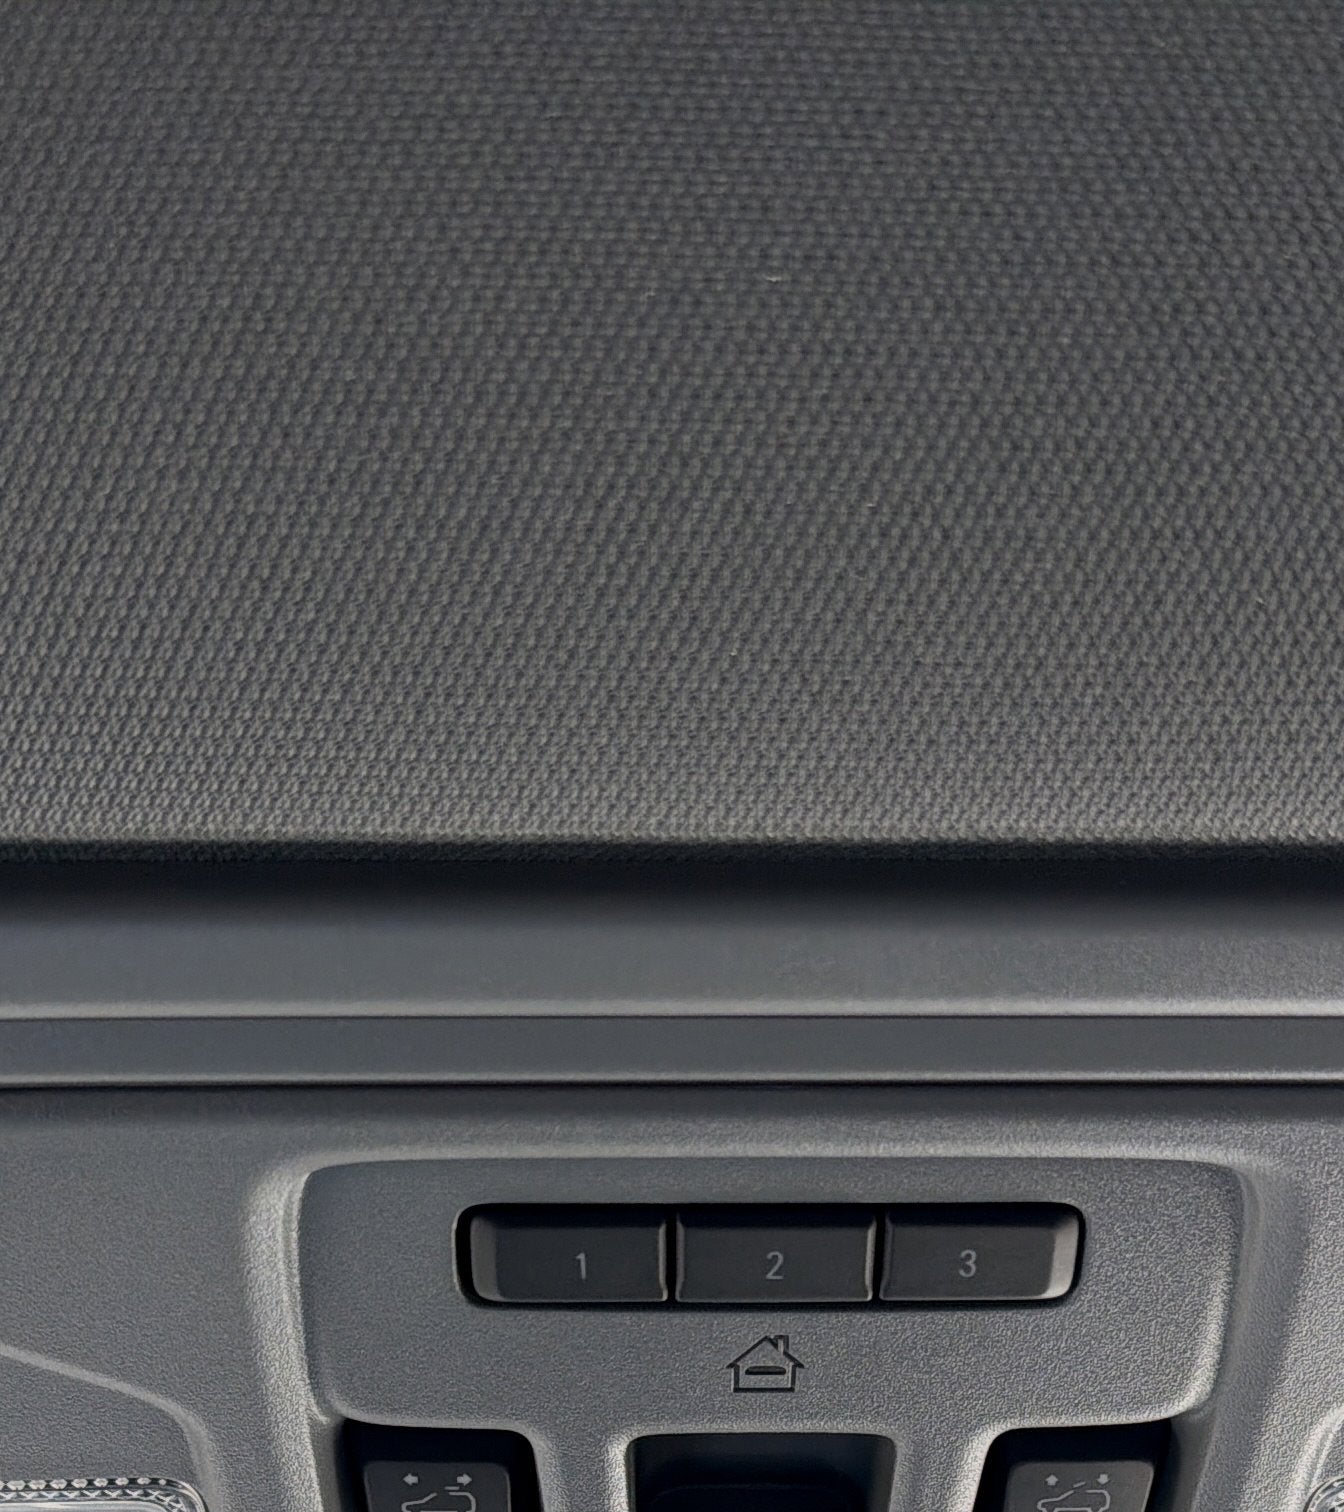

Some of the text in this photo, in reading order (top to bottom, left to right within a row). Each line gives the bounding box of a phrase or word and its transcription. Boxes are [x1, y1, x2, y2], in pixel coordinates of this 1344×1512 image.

[574, 1252, 590, 1280] 1
[765, 1251, 785, 1281] 2
[958, 1249, 978, 1279] 3
